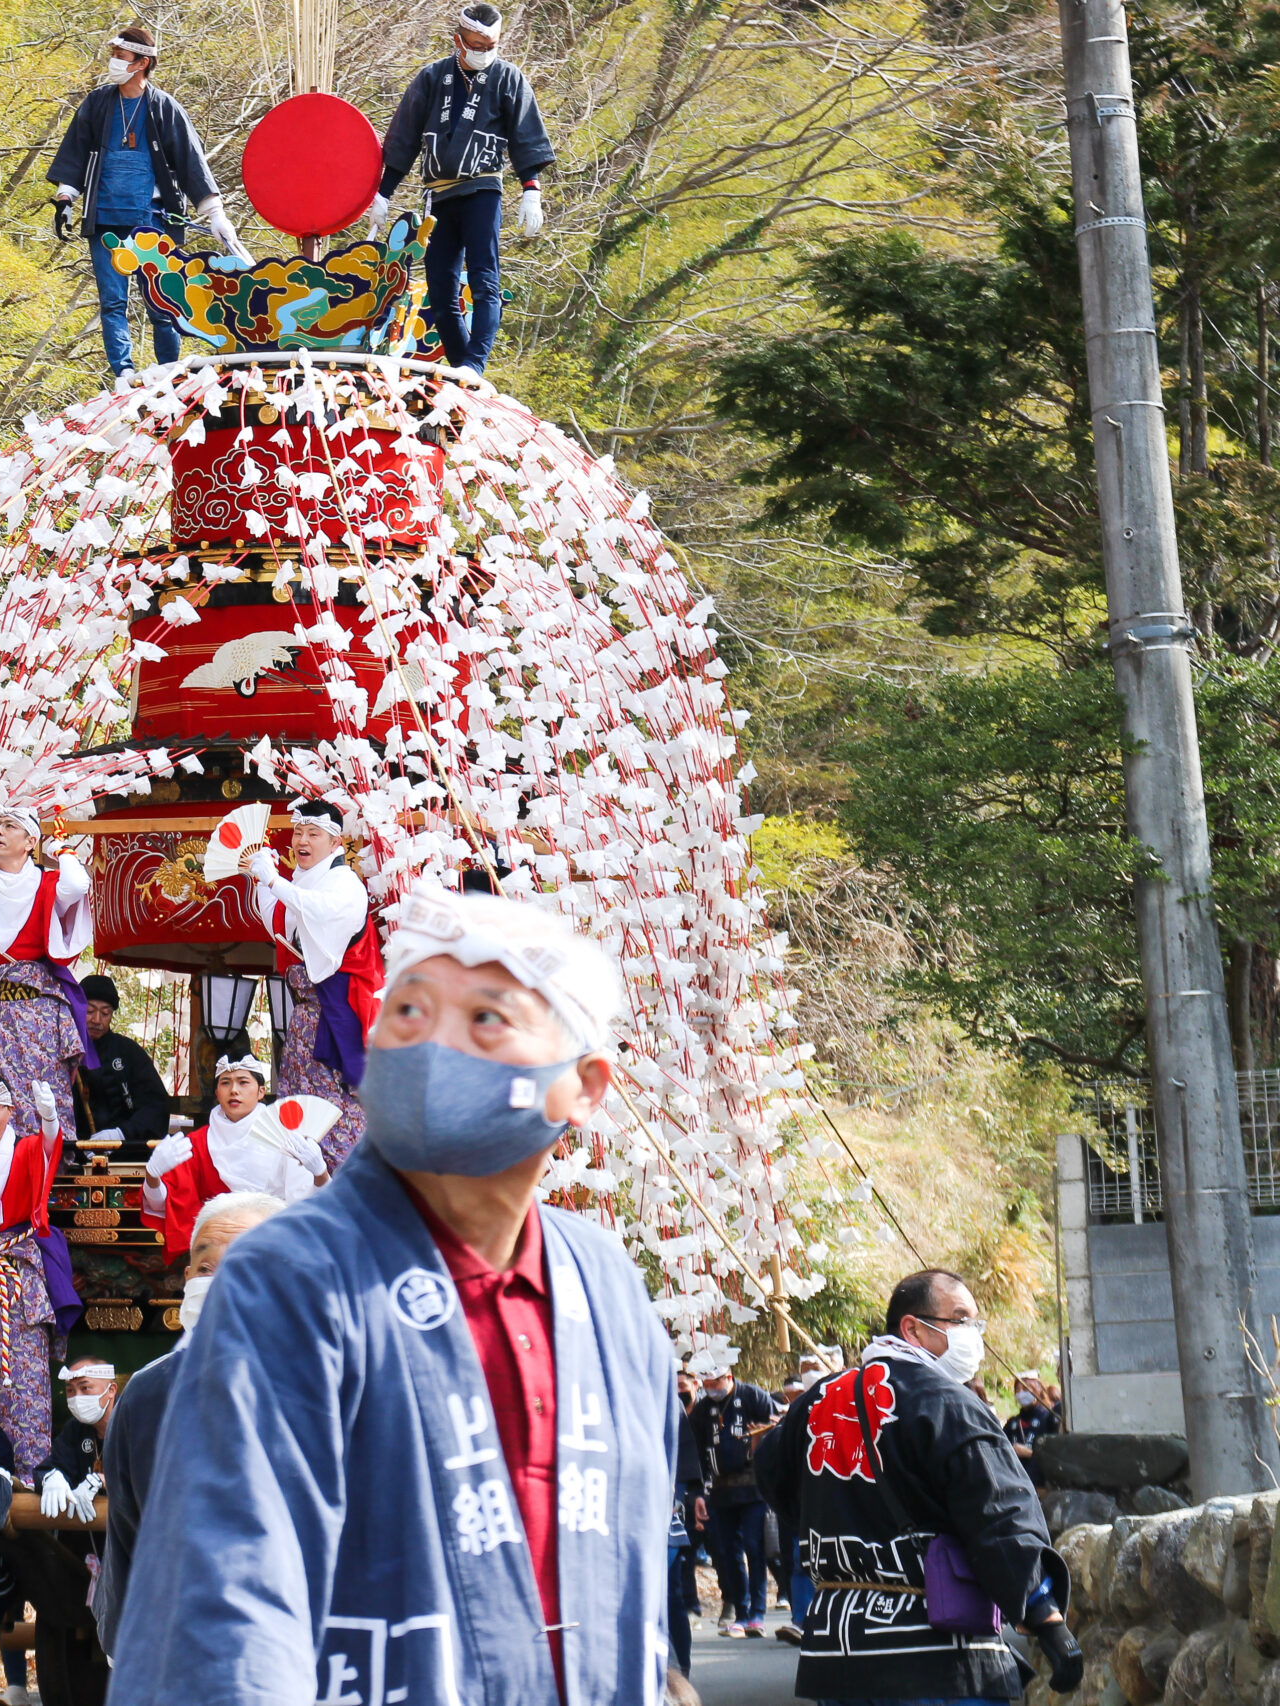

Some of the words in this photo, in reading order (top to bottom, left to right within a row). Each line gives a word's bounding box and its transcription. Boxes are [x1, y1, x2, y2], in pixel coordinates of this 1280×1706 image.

[461, 93, 481, 121] 上組
[444, 1392, 522, 1556] 上組
[557, 1383, 610, 1536] 上組
